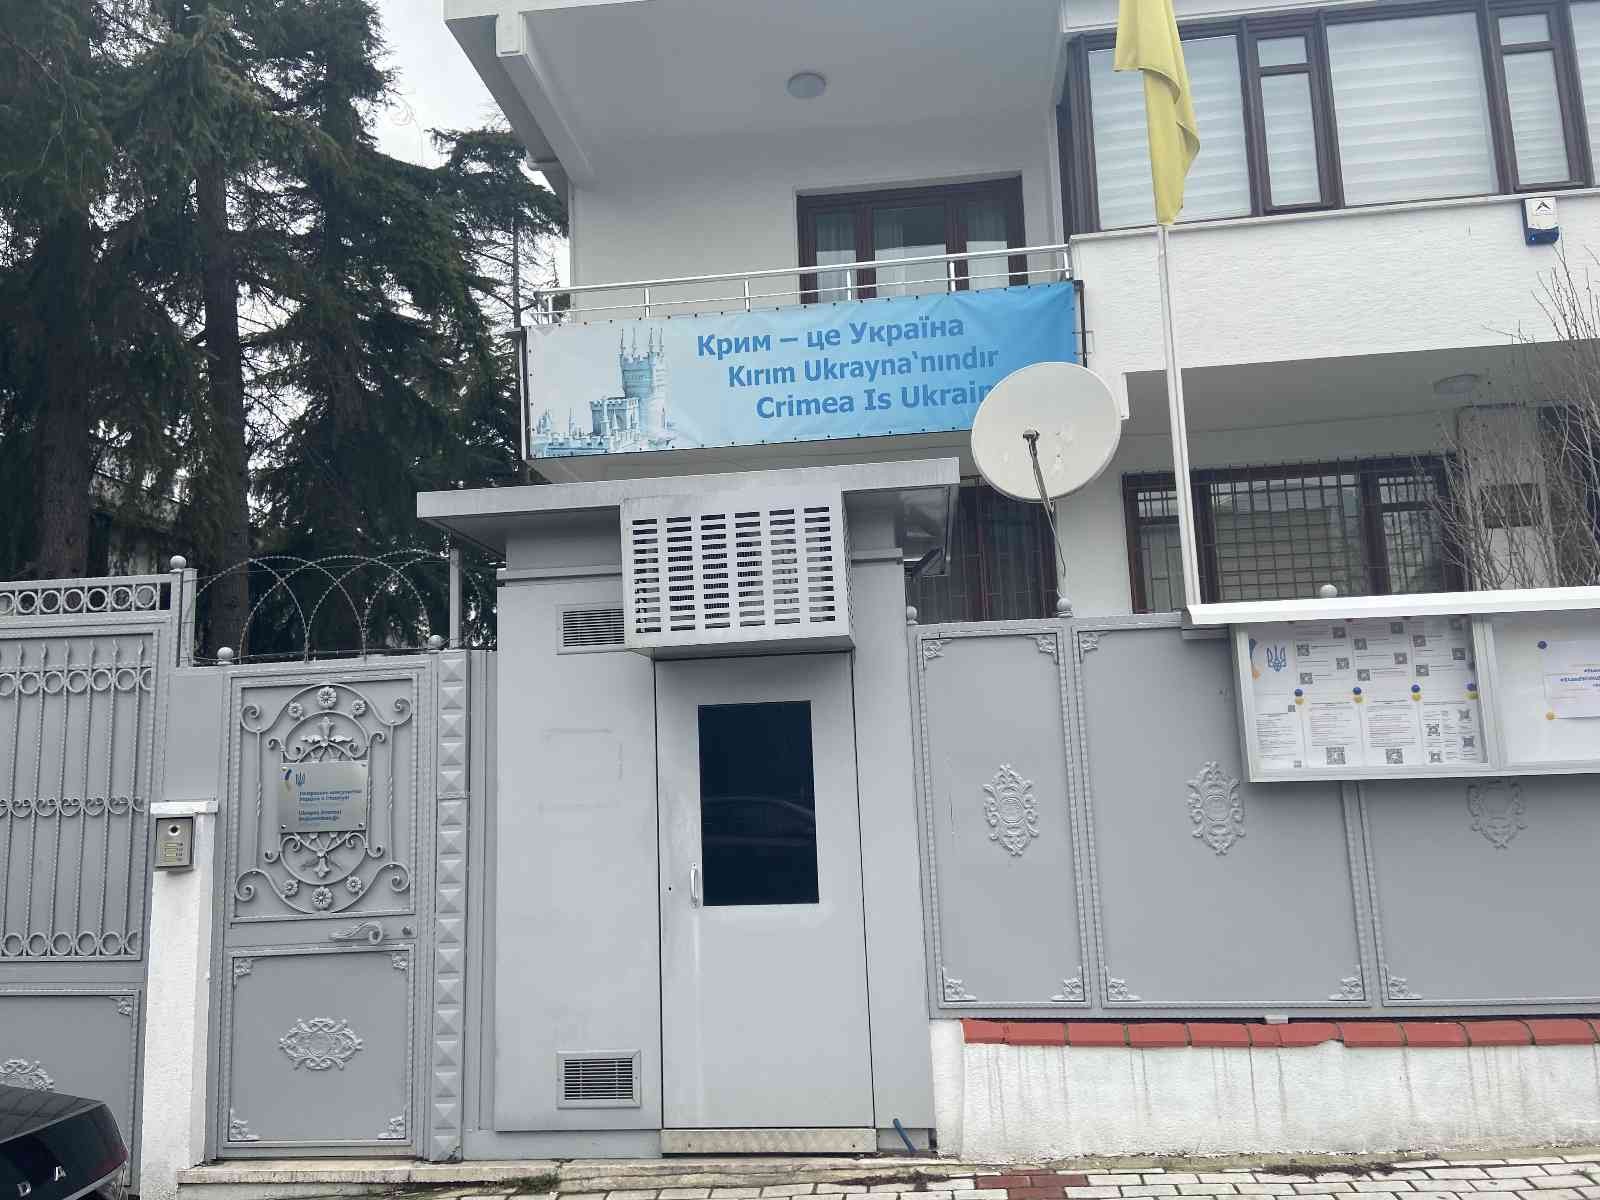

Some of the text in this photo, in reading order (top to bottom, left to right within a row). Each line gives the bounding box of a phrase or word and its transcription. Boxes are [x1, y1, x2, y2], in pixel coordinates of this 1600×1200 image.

[697, 334, 771, 360] Крим
[807, 329, 841, 350] це
[849, 315, 964, 347] Україна
[728, 365, 796, 387] Kırım
[757, 380, 994, 419] Crimea Is Ukrain
